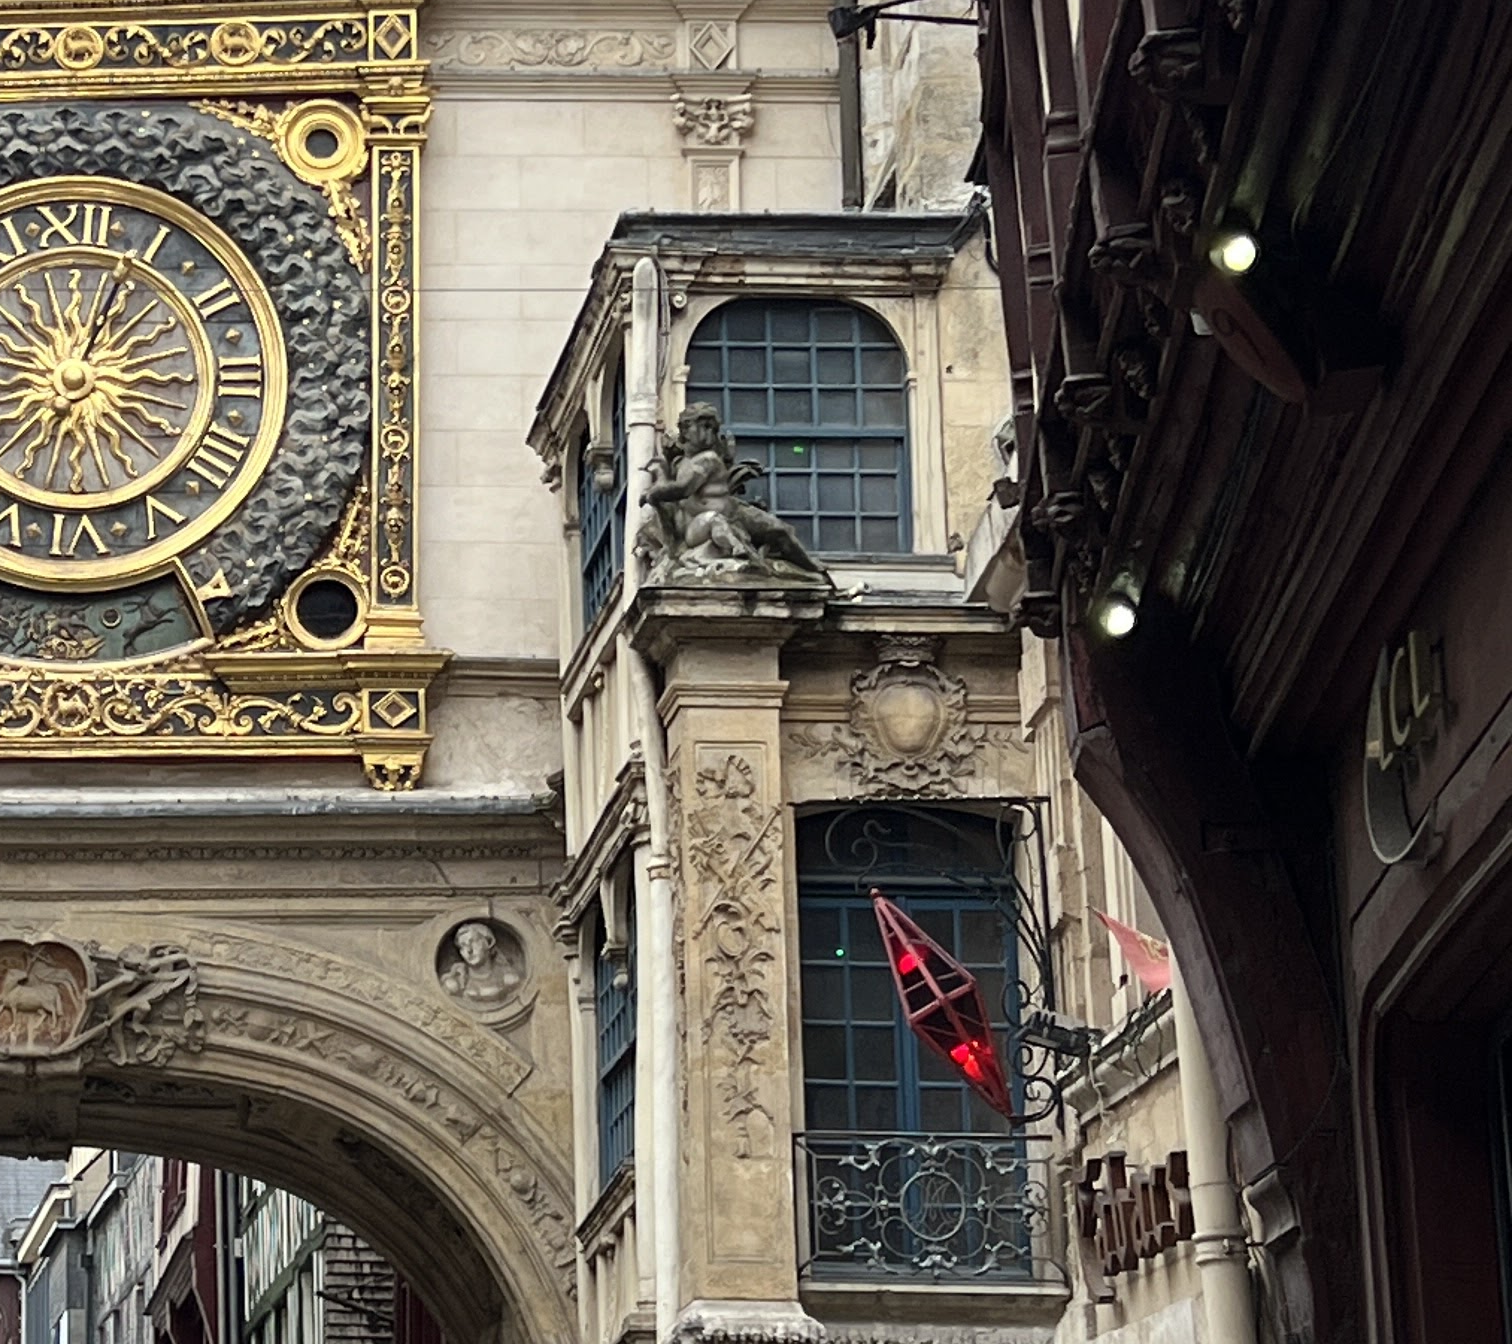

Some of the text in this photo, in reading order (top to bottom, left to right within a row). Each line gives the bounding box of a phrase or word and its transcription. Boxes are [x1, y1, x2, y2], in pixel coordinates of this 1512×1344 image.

[36, 203, 112, 249] XII
[143, 224, 171, 264] I
[192, 278, 241, 321] II
[218, 354, 262, 399] III
[186, 421, 250, 489] IIII
[48, 513, 112, 557] VI
[145, 495, 186, 540] V
[1374, 629, 1431, 771] LCL
